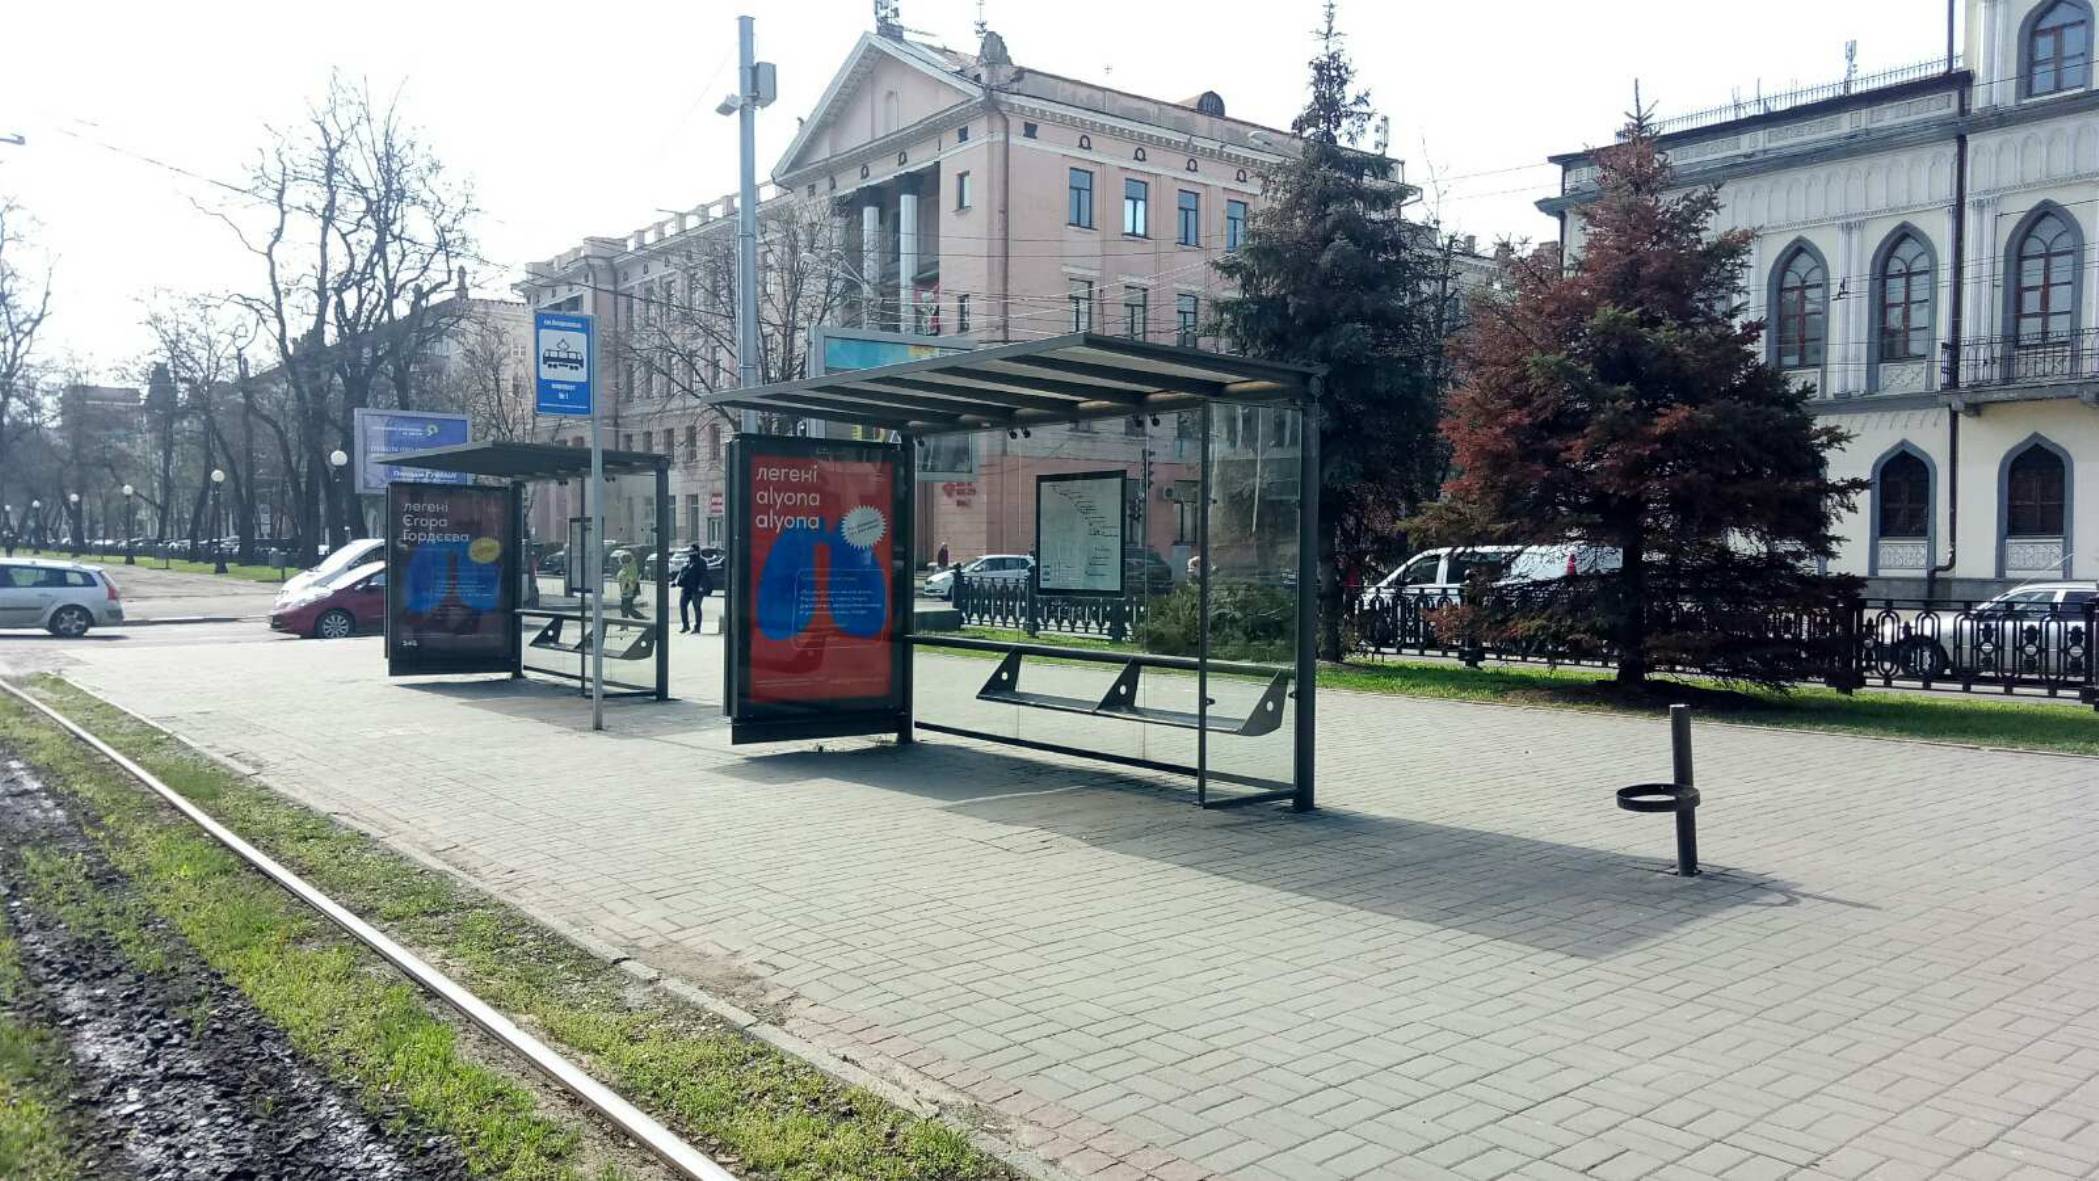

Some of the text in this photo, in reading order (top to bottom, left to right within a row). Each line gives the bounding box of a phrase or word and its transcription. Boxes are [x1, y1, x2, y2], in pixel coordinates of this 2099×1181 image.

[755, 464, 819, 484] легені
[755, 486, 821, 508] alyona
[402, 502, 449, 513] легені
[402, 514, 449, 528] Єгора
[755, 510, 821, 533] alyona
[402, 530, 470, 544] Гордєєва
